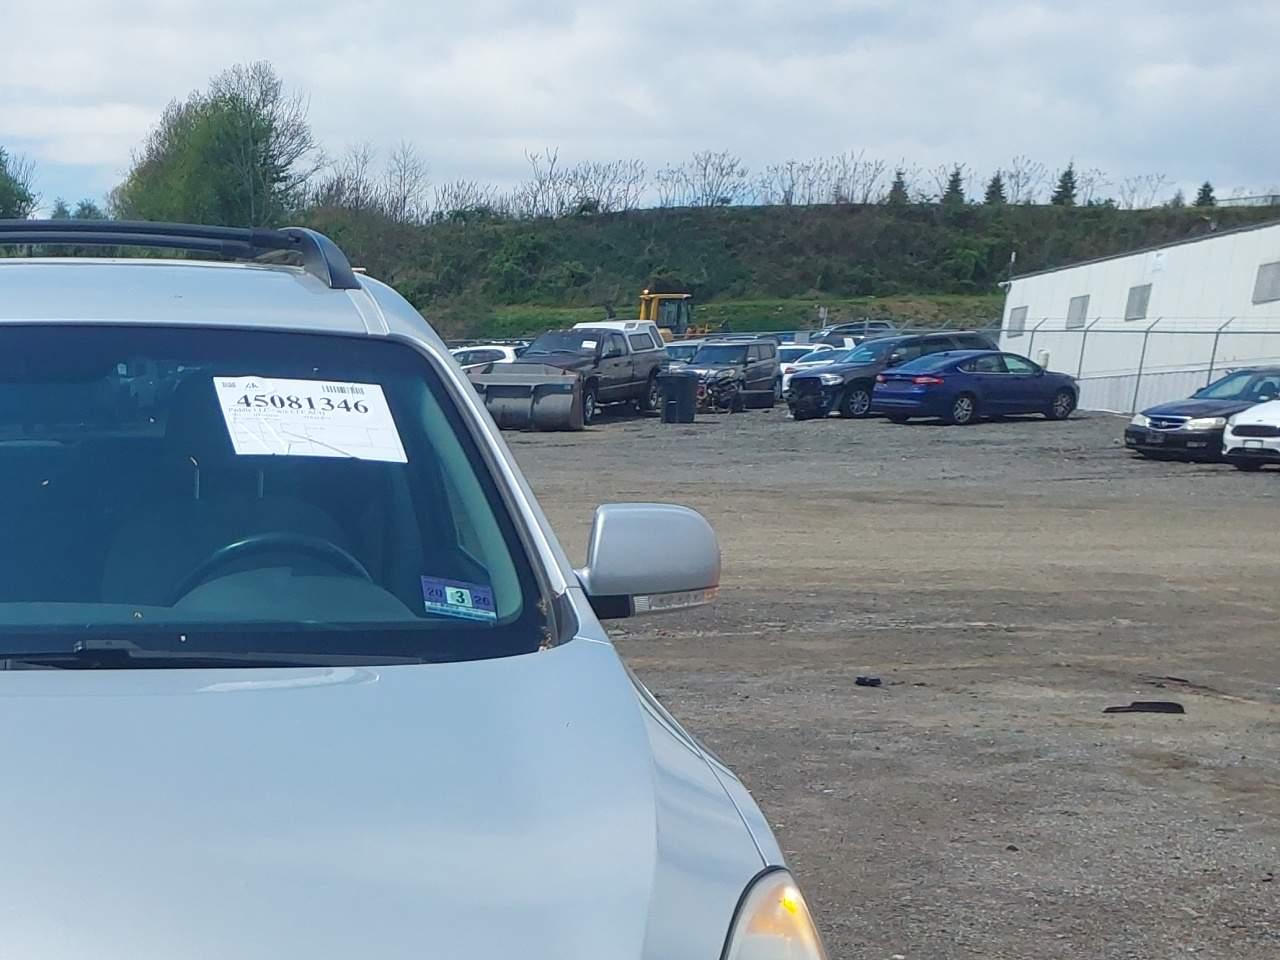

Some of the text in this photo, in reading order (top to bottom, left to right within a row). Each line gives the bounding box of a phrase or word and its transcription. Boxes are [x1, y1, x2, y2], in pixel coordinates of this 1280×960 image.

[237, 394, 369, 414] 45081346
[426, 587, 443, 598] 20
[455, 590, 466, 604] 3
